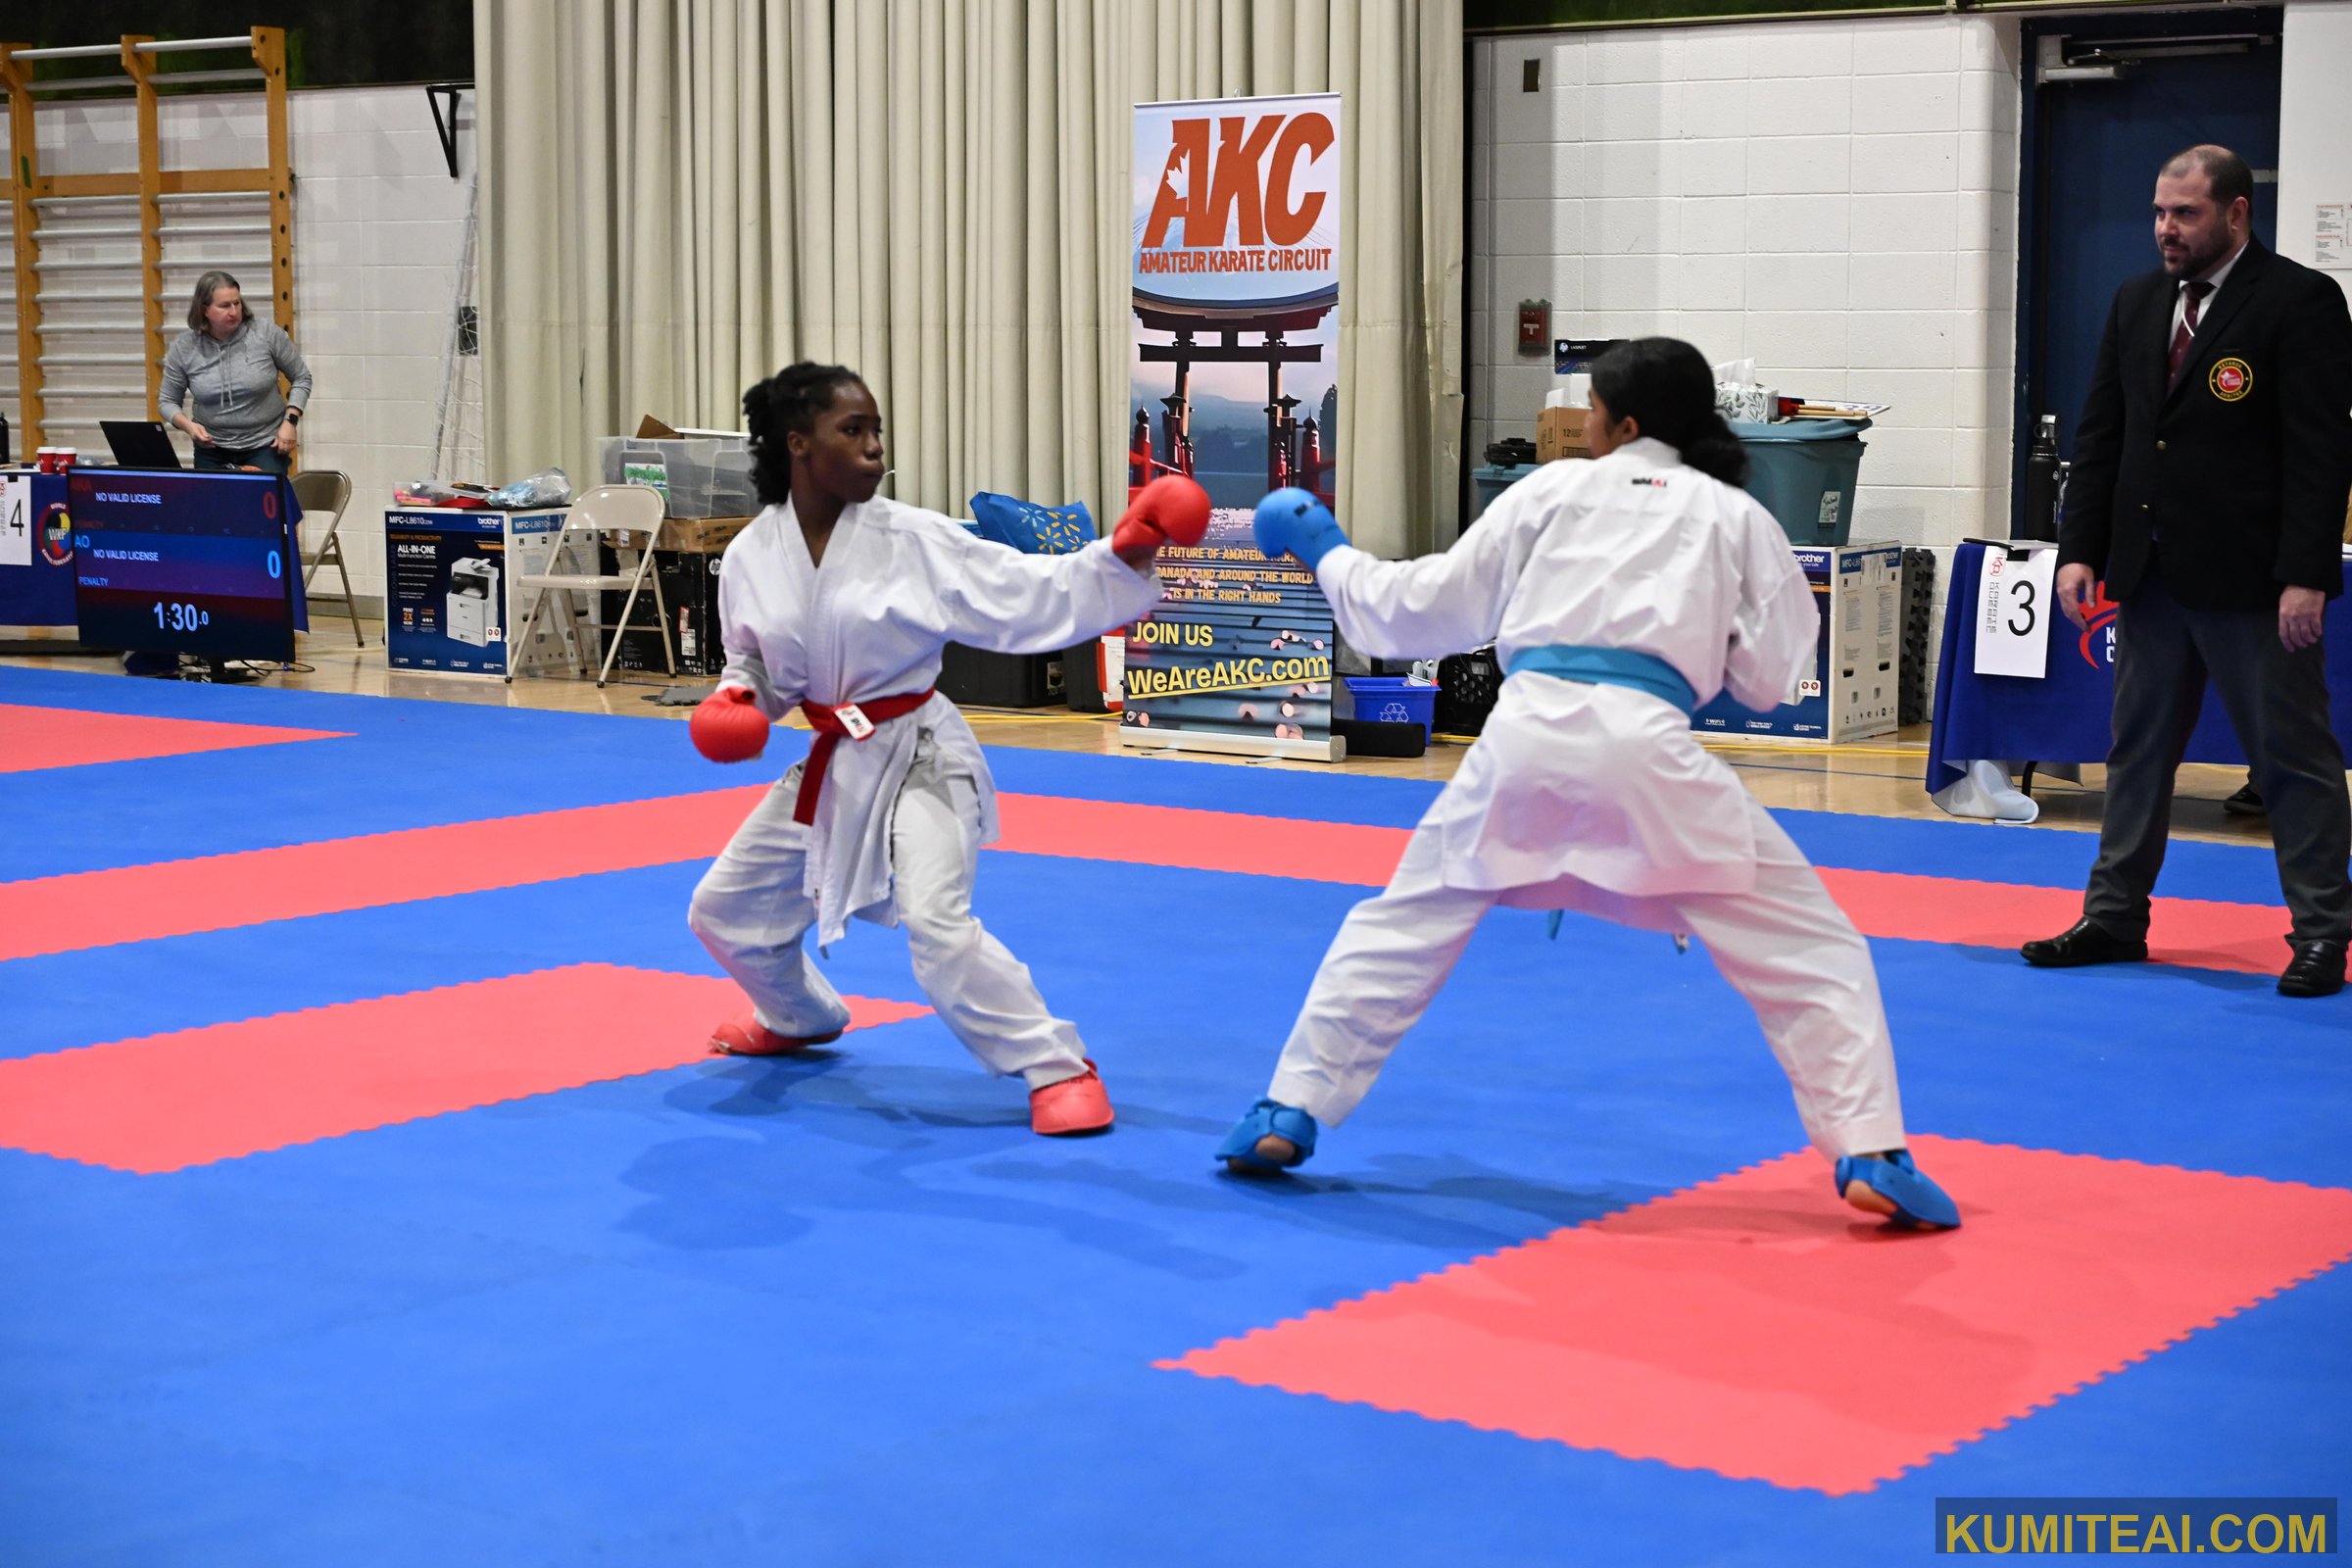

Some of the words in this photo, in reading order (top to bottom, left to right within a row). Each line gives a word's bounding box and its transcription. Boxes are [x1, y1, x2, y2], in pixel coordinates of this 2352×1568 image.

[1142, 112, 1335, 248] AKC
[1139, 252, 1205, 273] AMATEUR
[1208, 250, 1265, 272] KARATE
[1268, 249, 1332, 271] CIRCUIT
[95, 493, 107, 503] NO
[108, 493, 129, 503] VALID
[130, 494, 162, 505] LICENSE
[263, 492, 276, 518] 0
[10, 498, 24, 537] 4
[477, 516, 501, 525] brother
[74, 535, 90, 548] AO
[397, 544, 436, 555] ALL-IN-ONE
[93, 549, 105, 559] NO
[106, 550, 127, 560] VALID
[128, 551, 159, 562] LICENSE
[1168, 546, 1206, 559] FUTURE
[1207, 548, 1219, 560] OF
[268, 550, 281, 578] 0
[1197, 568, 1215, 580] AND
[1218, 569, 1255, 582] AROUND
[1259, 570, 1278, 583] THE
[1281, 571, 1313, 584] WORLD
[1172, 588, 1181, 599] IS
[1184, 588, 1194, 600] IN
[1197, 589, 1215, 601] THE
[1218, 590, 1245, 602] RIGHT
[1249, 590, 1281, 604] HANDS
[2008, 580, 2035, 636] 3
[1132, 622, 1179, 644] JOIN
[1185, 624, 1213, 646] US
[1127, 656, 1330, 696] WeAreAKC.com
